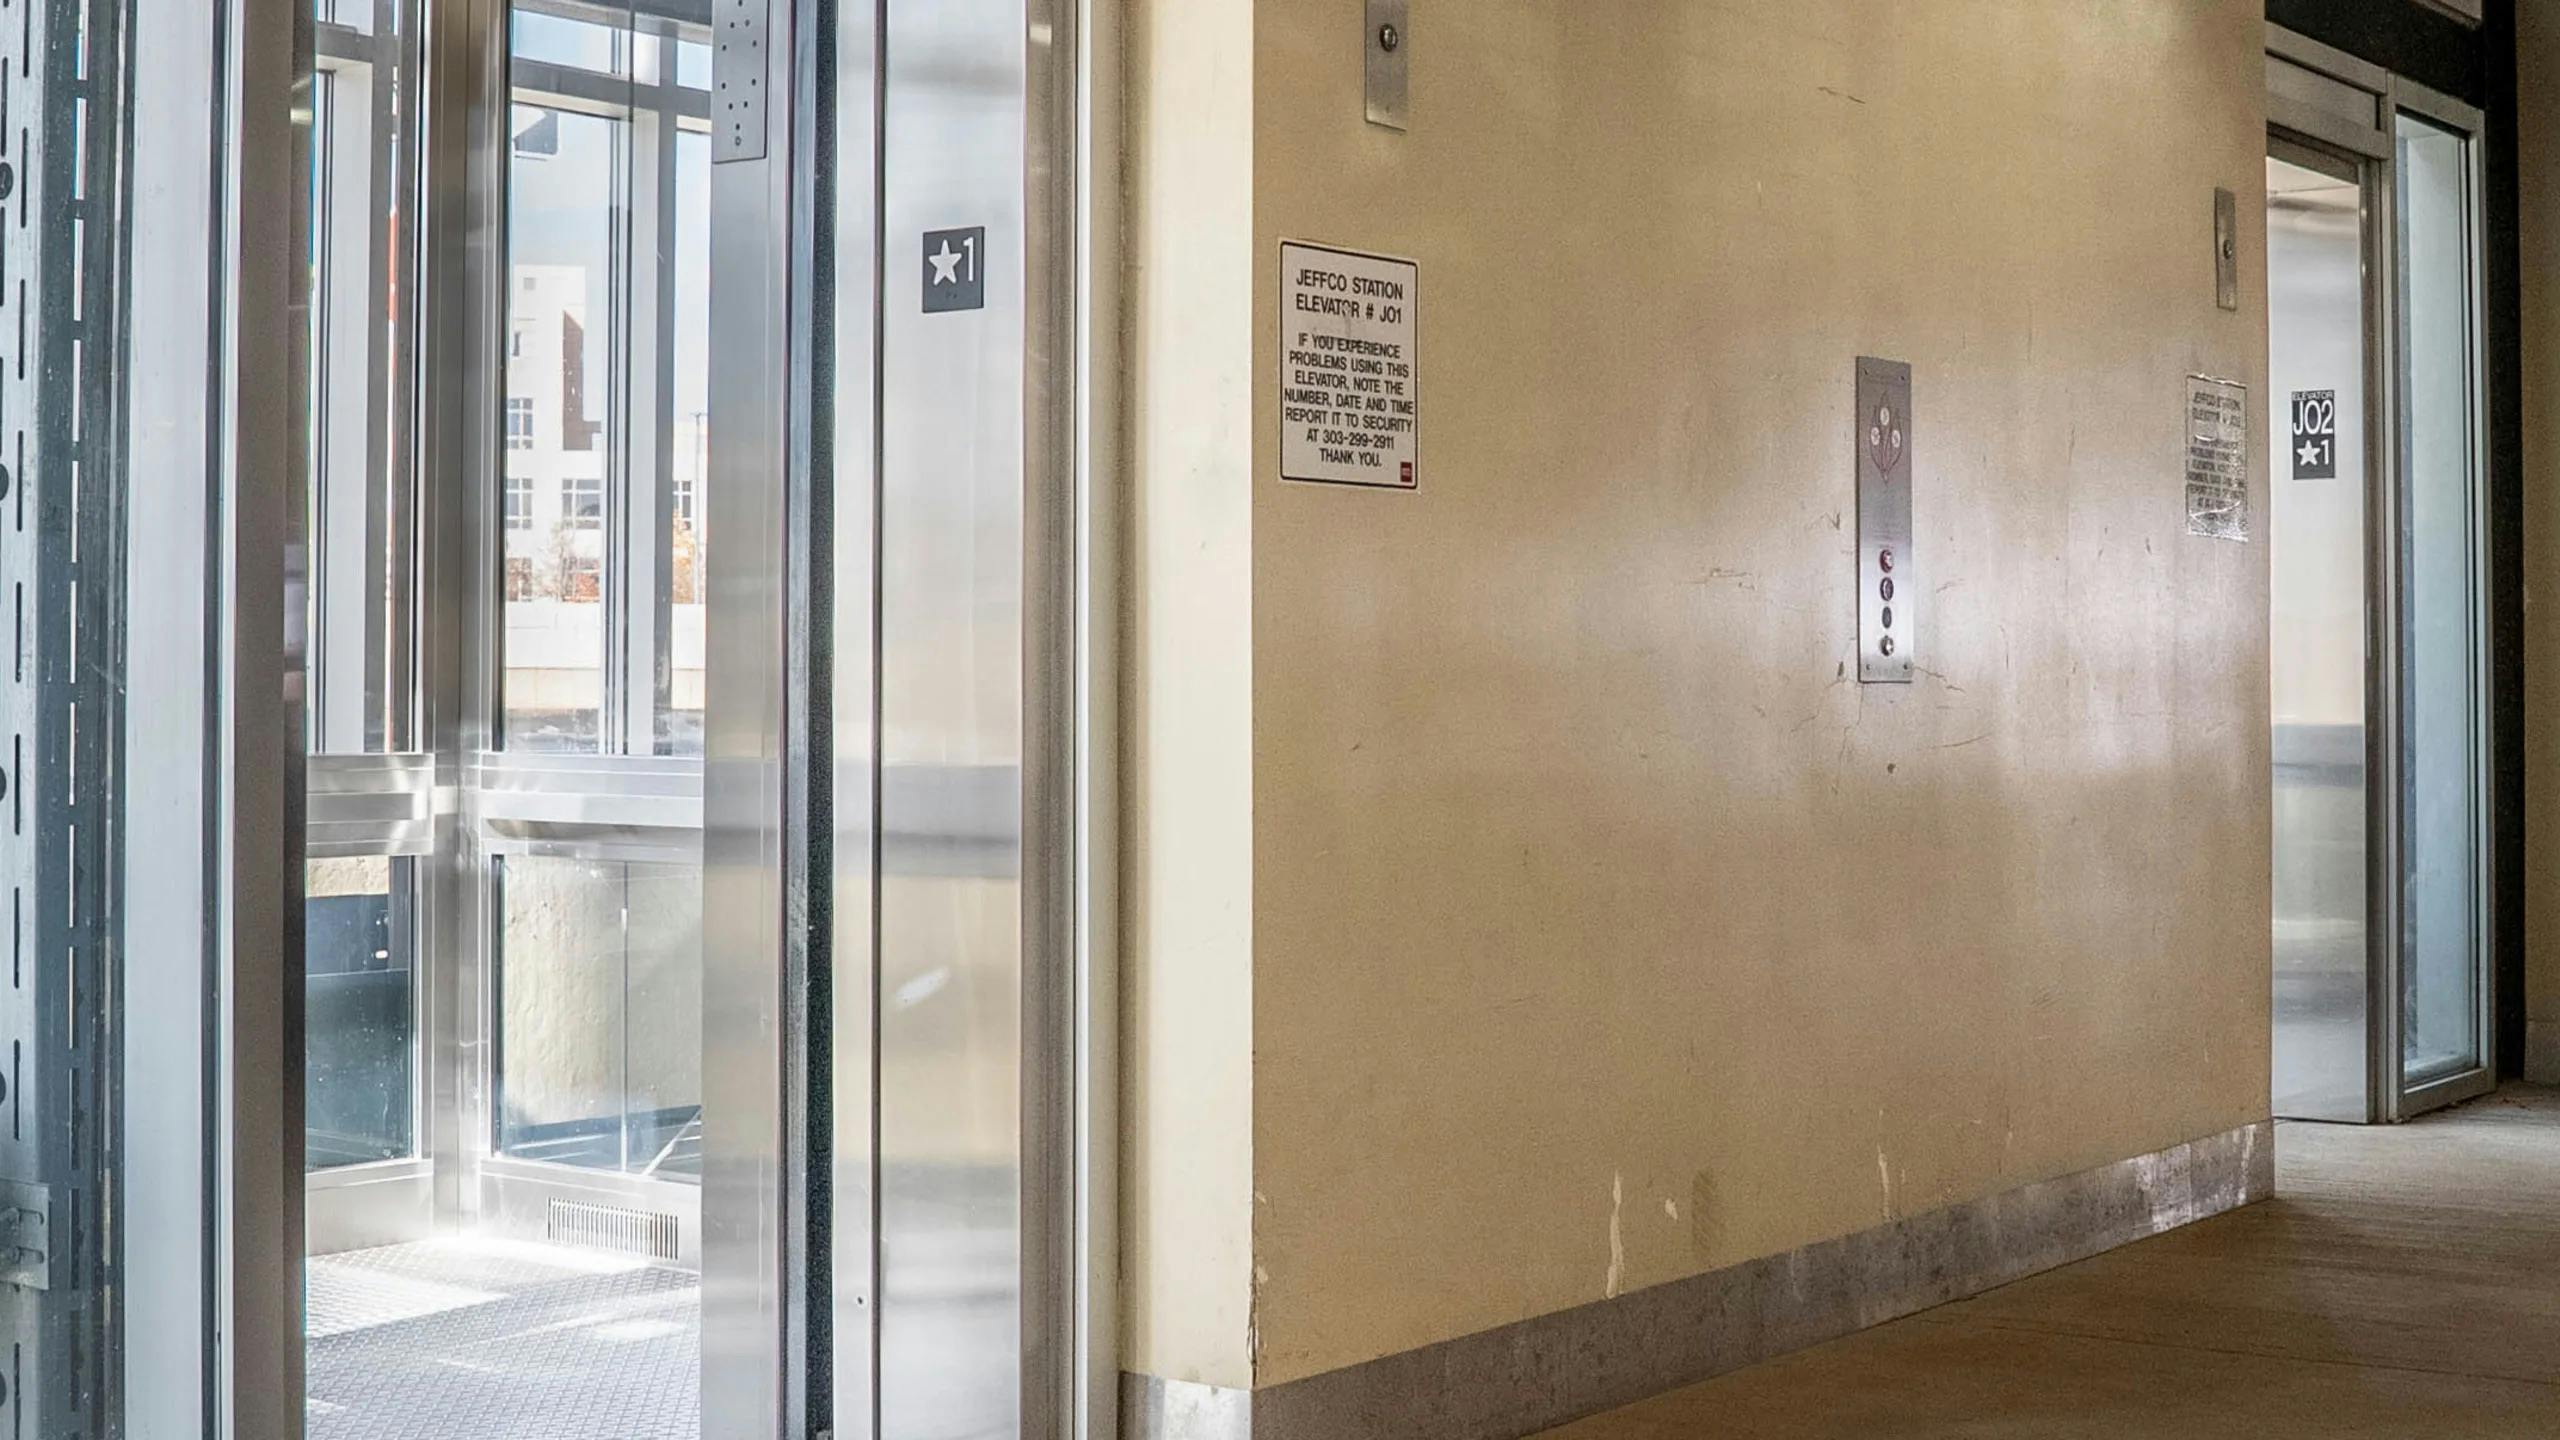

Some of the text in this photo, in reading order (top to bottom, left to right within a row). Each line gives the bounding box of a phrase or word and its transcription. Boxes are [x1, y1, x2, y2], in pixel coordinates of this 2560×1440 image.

[963, 236, 974, 282] 1
[1296, 269, 1403, 300] JEFFCO STATION
[1296, 293, 1360, 318] ELEVATOR
[1365, 303, 1374, 319] #
[1298, 333, 1401, 359] IF YOU EXPERIENCE
[1289, 350, 1409, 378] PROBLEMS USING THIS
[1295, 370, 1404, 396] ELEVATOR, NOTE THE
[1284, 388, 1413, 415] NUMBER, DATE AND TIME
[1285, 407, 1413, 433] REPORT IT TO SECURITY
[1306, 428, 1394, 450] AT 303-299-2911
[2320, 439, 2329, 465] 1
[1320, 448, 1382, 467] THANK YOU.
